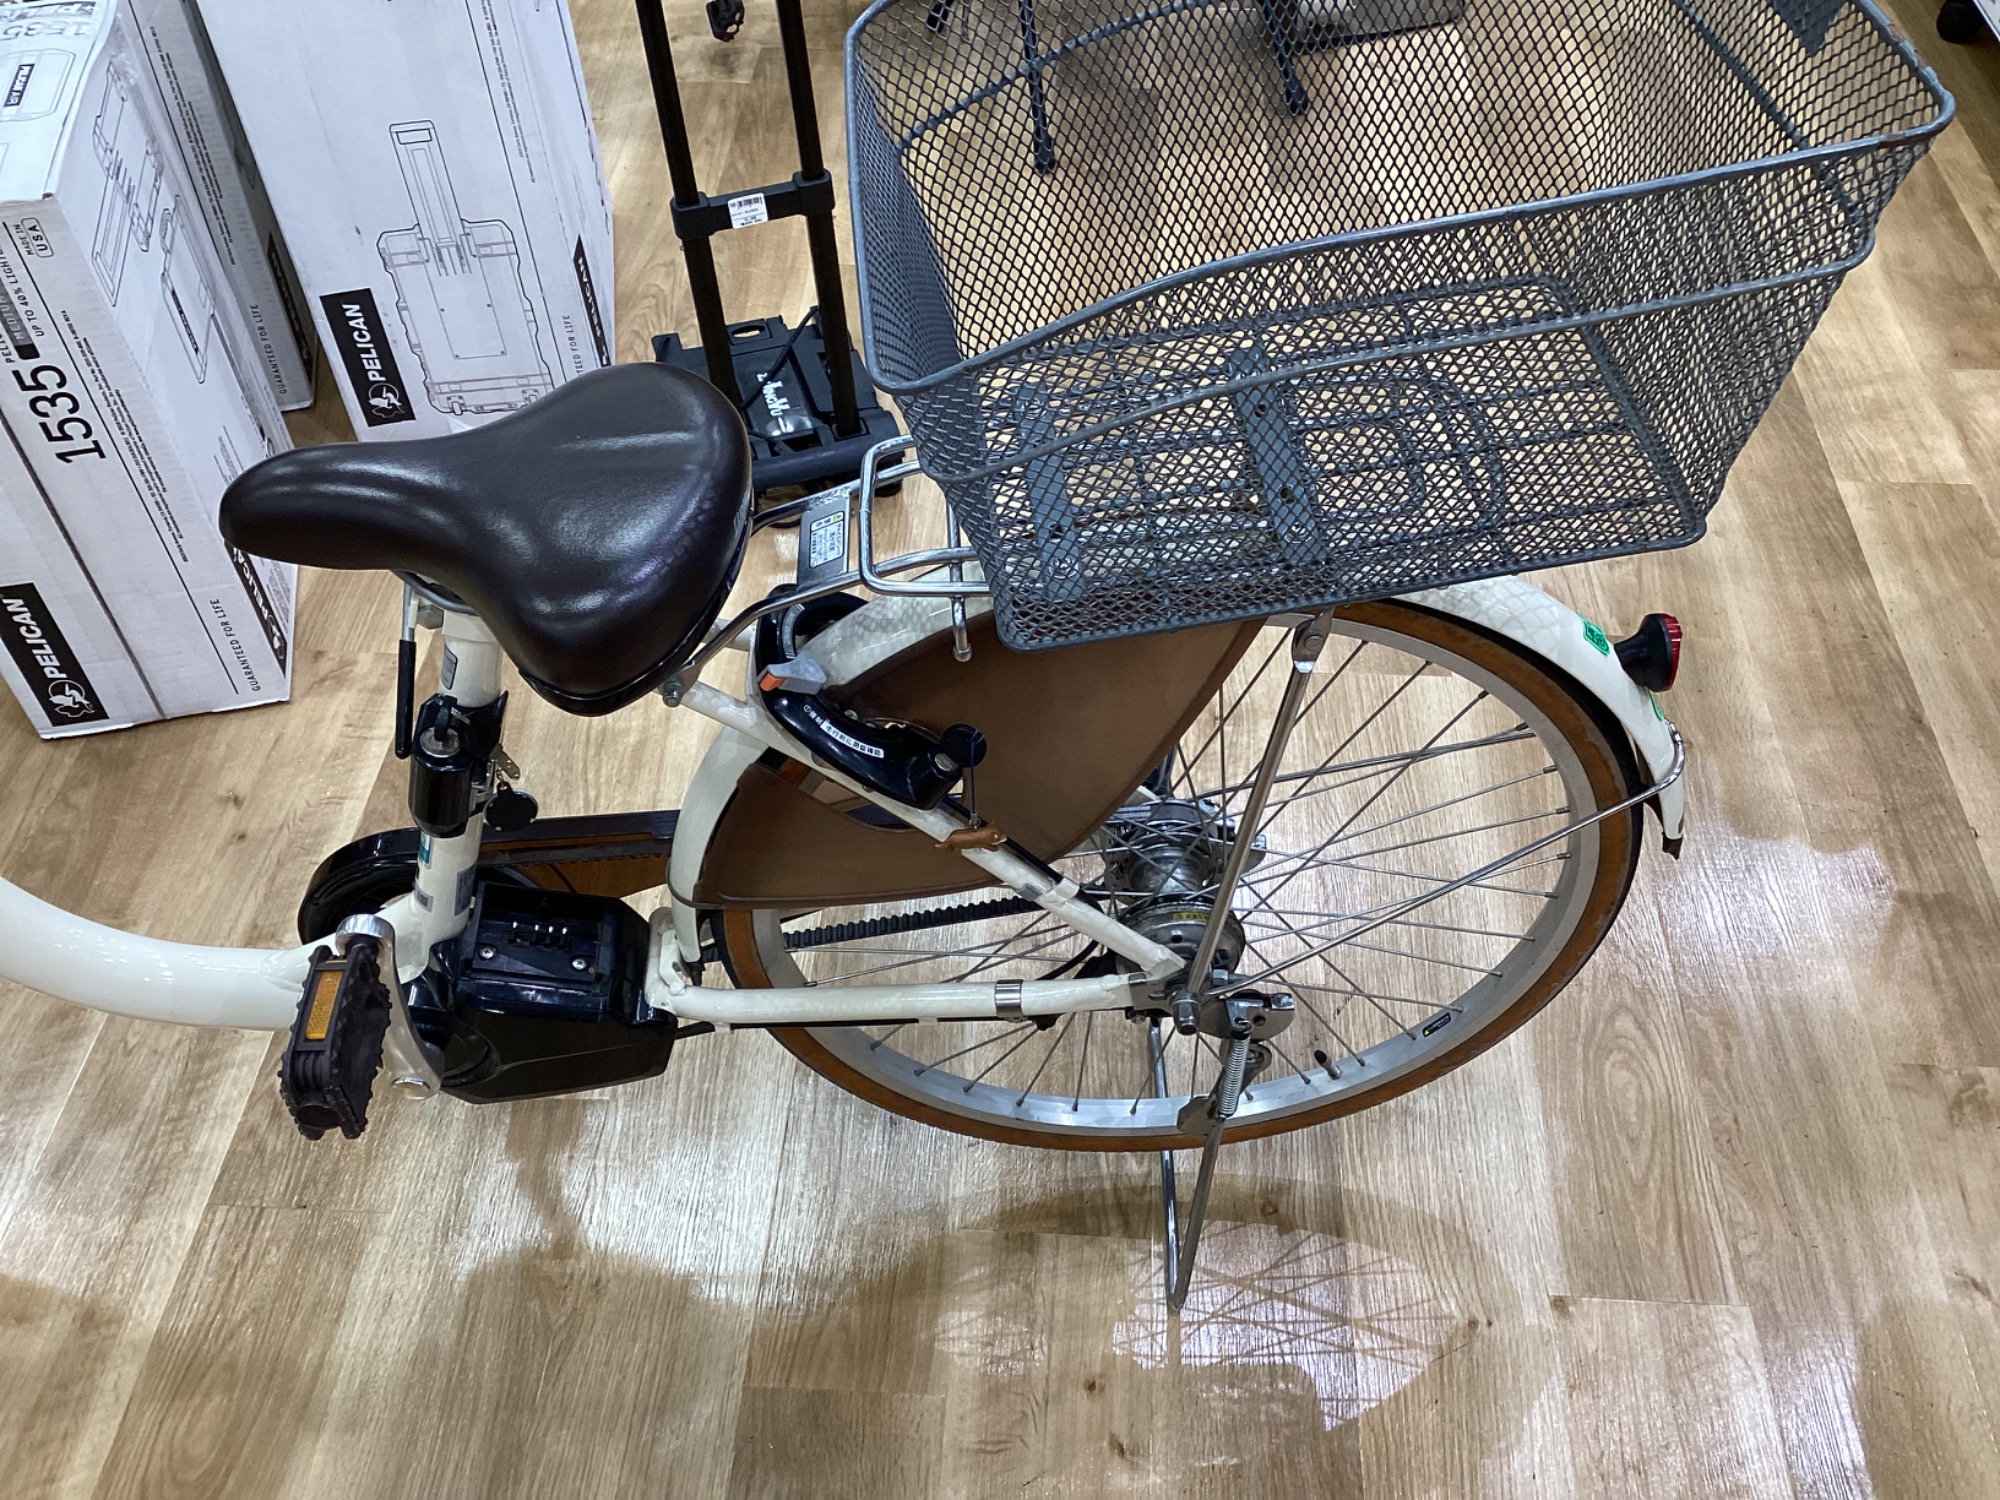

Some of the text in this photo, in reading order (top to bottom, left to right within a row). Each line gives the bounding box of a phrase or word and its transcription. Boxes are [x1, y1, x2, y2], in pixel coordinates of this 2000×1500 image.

[13, 224, 35, 256] MADE IN
[27, 224, 48, 251] USA
[13, 287, 29, 307] 40%
[25, 309, 37, 321] TO
[32, 325, 45, 337] UP
[250, 304, 288, 395] GUARANTEED FOR LIFE
[342, 304, 386, 381] PELICAN
[562, 315, 578, 352] FOR LIFE
[11, 365, 106, 464] 1535
[2, 599, 68, 678] PELICAN
[210, 598, 261, 692] GUARANTEED FOR LIFE
